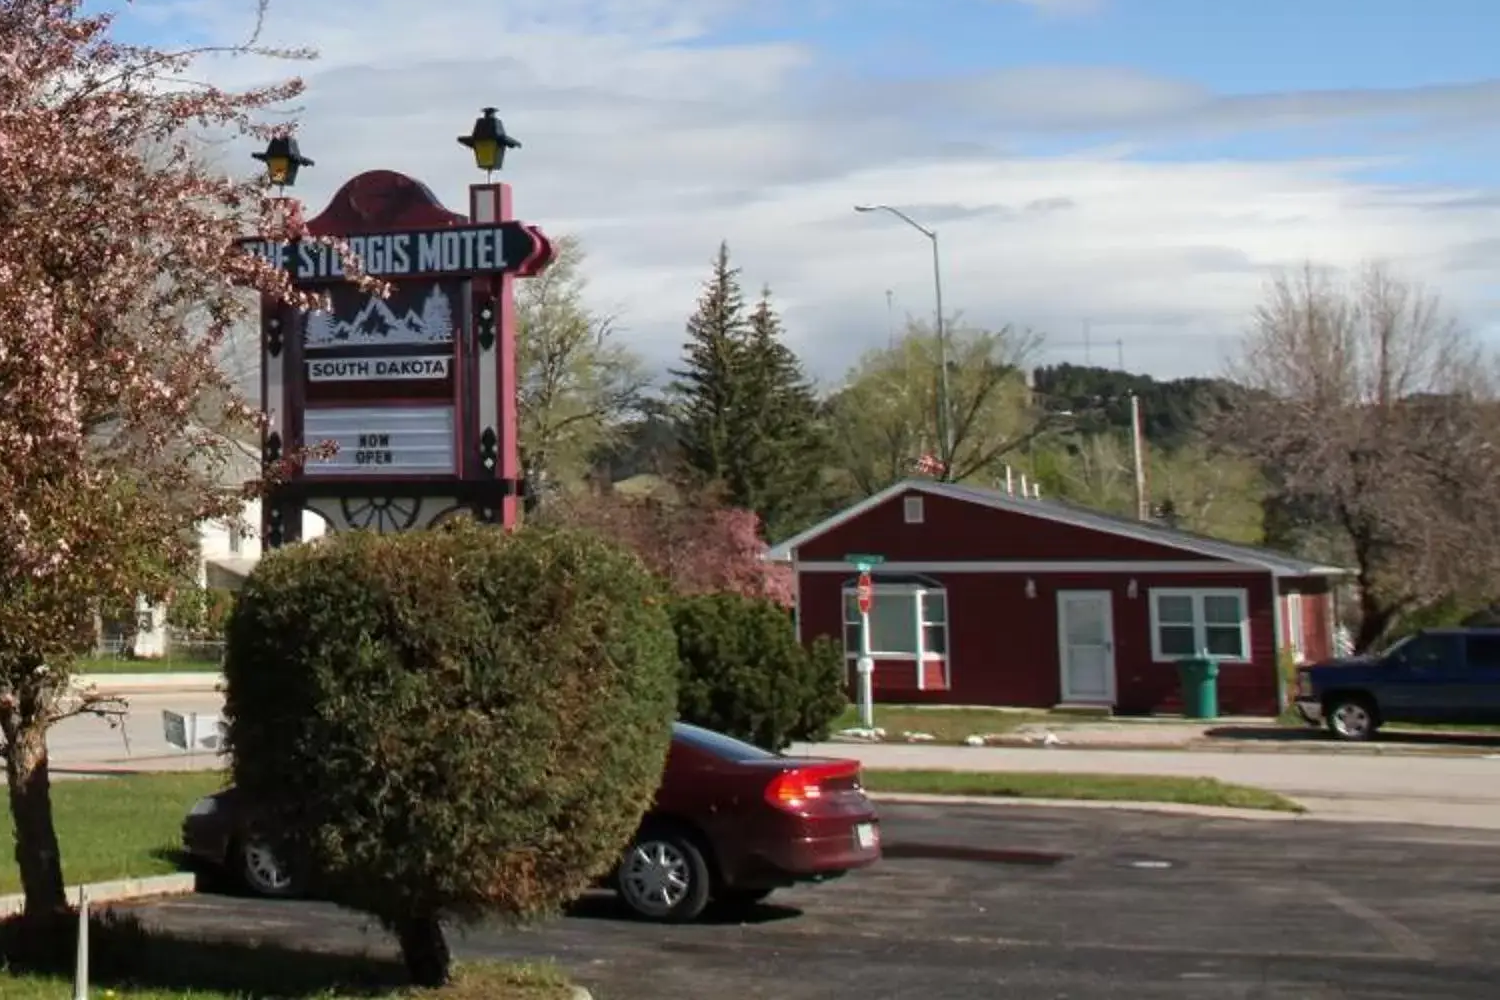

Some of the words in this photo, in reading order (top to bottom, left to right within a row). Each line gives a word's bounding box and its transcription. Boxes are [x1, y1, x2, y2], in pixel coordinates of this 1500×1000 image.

[418, 228, 508, 272] MOTEL
[311, 361, 369, 377] SOUTH
[375, 359, 445, 376] DAKOTA
[358, 433, 391, 448] NOW
[355, 450, 393, 465] OPEN
